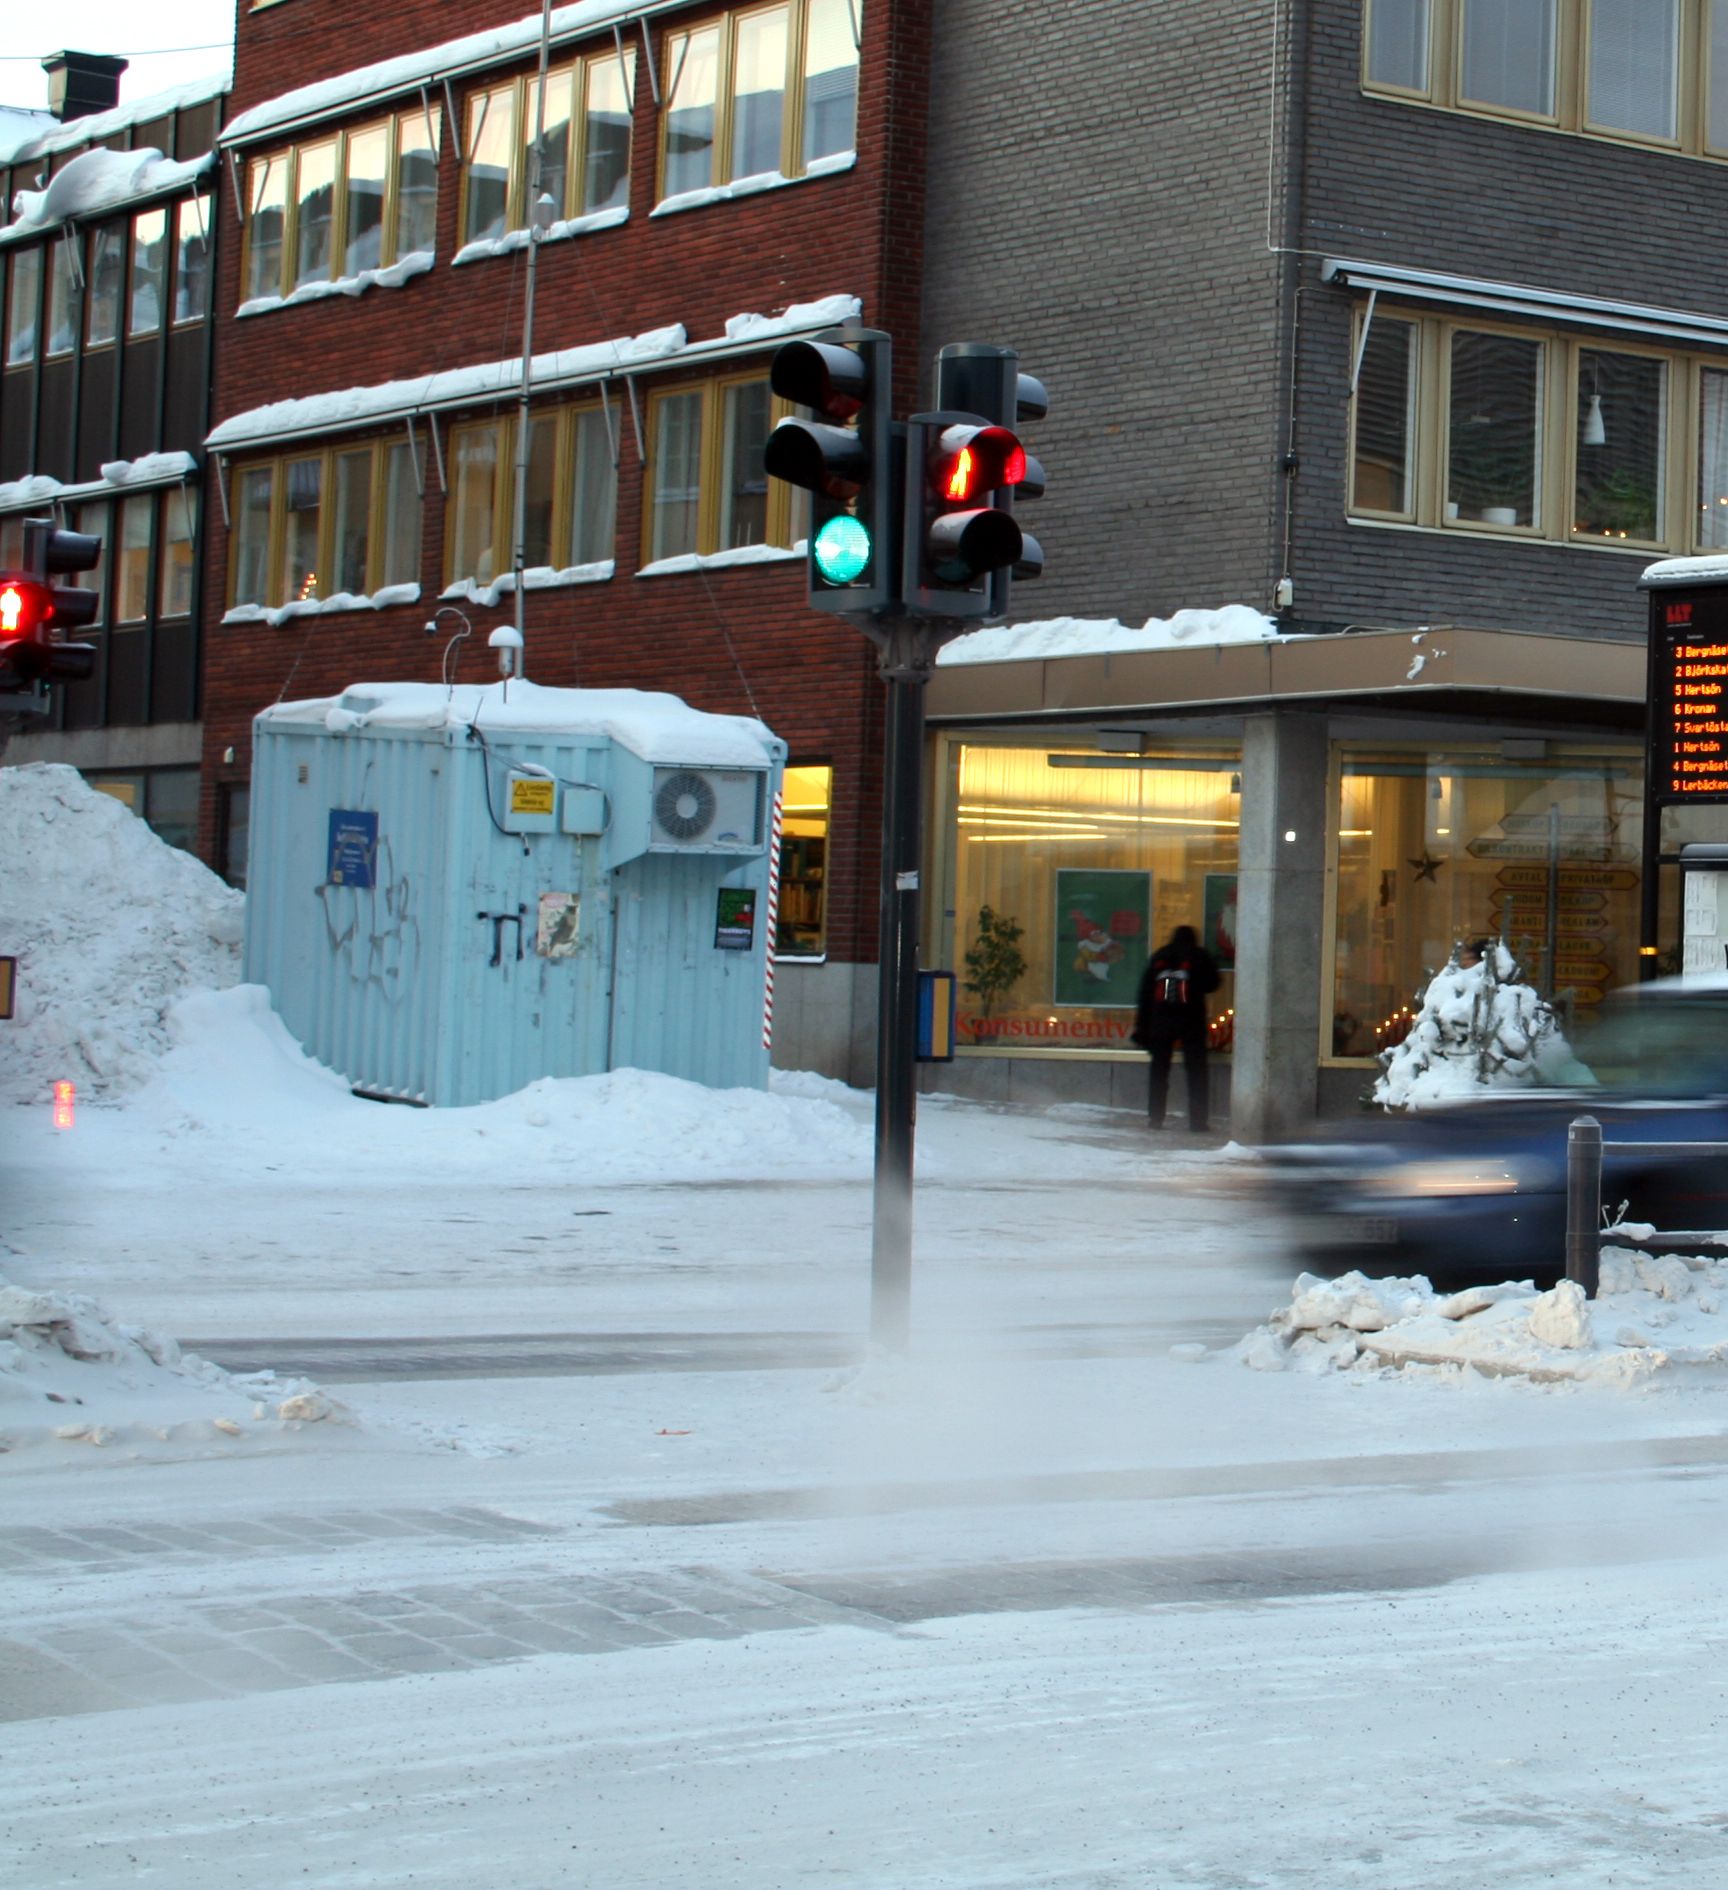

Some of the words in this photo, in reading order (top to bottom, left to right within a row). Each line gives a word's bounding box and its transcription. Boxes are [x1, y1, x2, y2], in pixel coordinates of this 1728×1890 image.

[1675, 646, 1682, 658] 3
[1675, 666, 1682, 677] 2
[1675, 685, 1682, 696] 5
[1684, 683, 1721, 696] Hertsön
[1674, 704, 1681, 715] 6
[1684, 704, 1716, 715] Kronan
[1674, 722, 1681, 733] 7
[1674, 742, 1679, 752] 1
[1683, 741, 1720, 752] Hertsön
[1673, 761, 1680, 771] 4
[1673, 780, 1680, 791] 9
[955, 1011, 1131, 1038] Konsumentv
